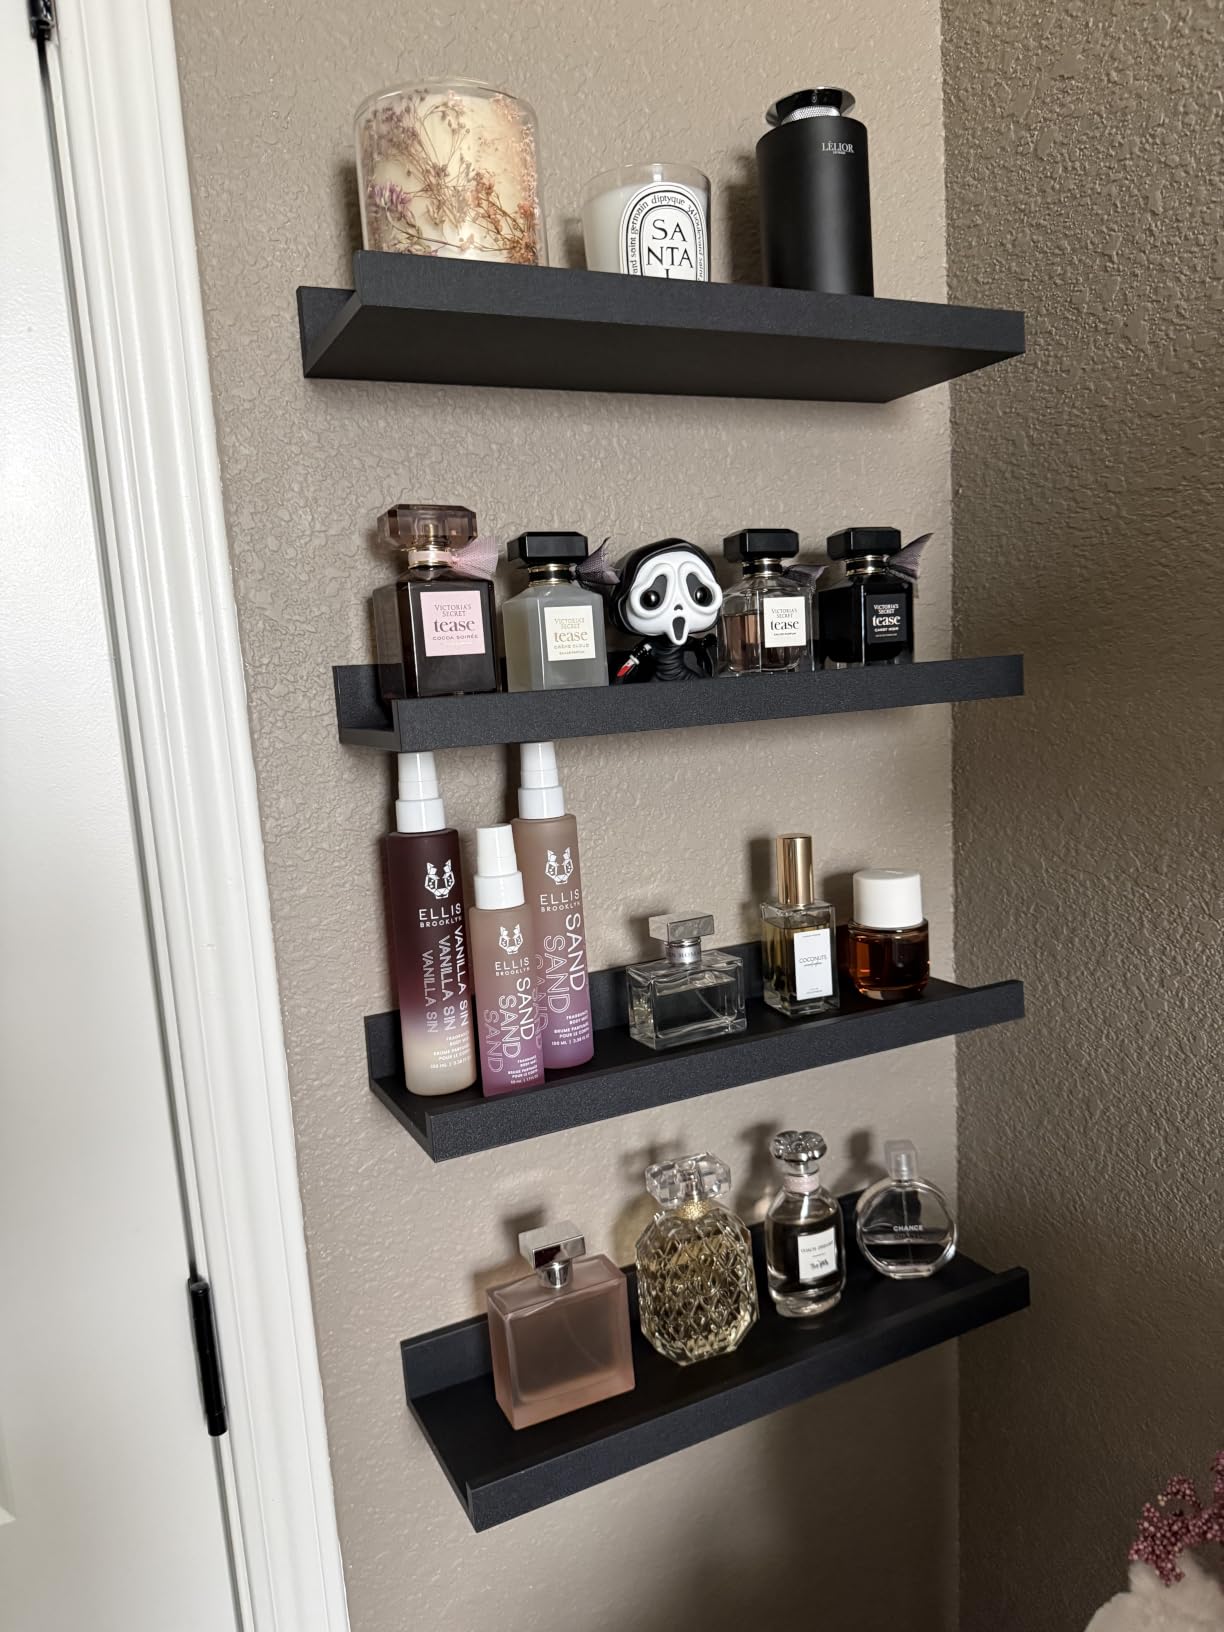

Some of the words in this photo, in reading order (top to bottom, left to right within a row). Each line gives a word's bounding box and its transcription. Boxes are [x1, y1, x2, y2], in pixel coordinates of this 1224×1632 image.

[651, 194, 686, 206] diptyque
[630, 201, 649, 236] germain
[651, 218, 688, 243] SA
[629, 236, 638, 257] saint
[646, 245, 694, 269] NTA
[434, 603, 472, 611] VICTORIA'S
[441, 610, 467, 618] SECRET
[433, 618, 476, 633] tease
[770, 619, 800, 631] tease
[872, 615, 901, 627] tease
[552, 631, 589, 643] tease
[539, 888, 580, 905] ELLIS
[418, 902, 462, 921] ELLIS
[454, 924, 468, 995] VANILLA
[565, 912, 586, 991] SAND
[438, 934, 454, 1001] VANILLA
[494, 956, 530, 972] ELLIS
[543, 935, 571, 1014] SAND
[421, 949, 437, 1007] VANILLA
[443, 1005, 457, 1032] SIN
[459, 999, 470, 1027] SIN
[516, 977, 536, 1040] SAND
[426, 1011, 439, 1033] SIN
[498, 994, 522, 1059] SAND
[483, 1009, 504, 1073] SAND
[892, 1224, 924, 1232] CHANCE
